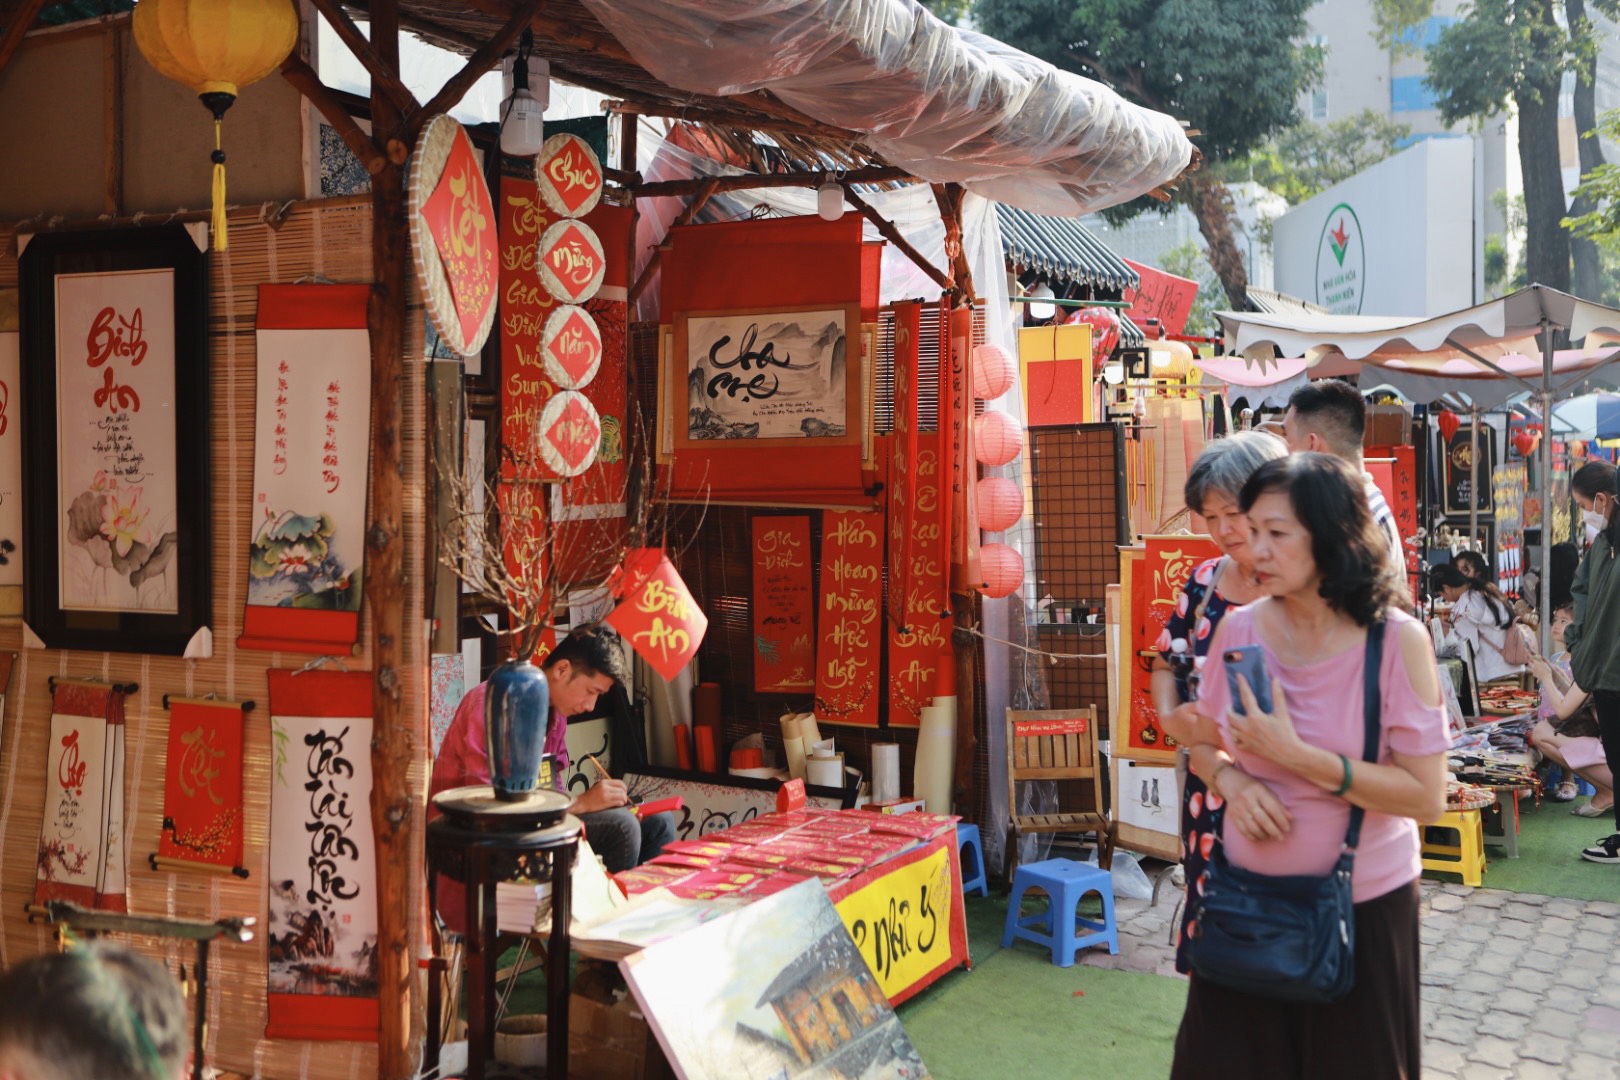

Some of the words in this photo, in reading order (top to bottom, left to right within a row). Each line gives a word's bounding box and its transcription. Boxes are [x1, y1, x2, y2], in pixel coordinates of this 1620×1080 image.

[550, 150, 596, 192] Chúc
[450, 156, 486, 274] Tết
[507, 194, 548, 238] Tết
[553, 241, 594, 284] Mừng
[507, 279, 553, 307] Gia
[560, 326, 595, 364] Năm
[709, 323, 820, 371] Cha
[506, 373, 553, 399] Sum
[826, 517, 877, 551] Hân
[826, 554, 877, 592] Hoan
[635, 580, 694, 623] Bình
[826, 589, 877, 625] Mừng
[633, 617, 690, 662] An
[825, 617, 869, 656] Hội
[822, 657, 867, 689] Ngộ
[303, 726, 354, 779] Tấn
[304, 779, 354, 819] Tài
[305, 819, 359, 861] Tấn
